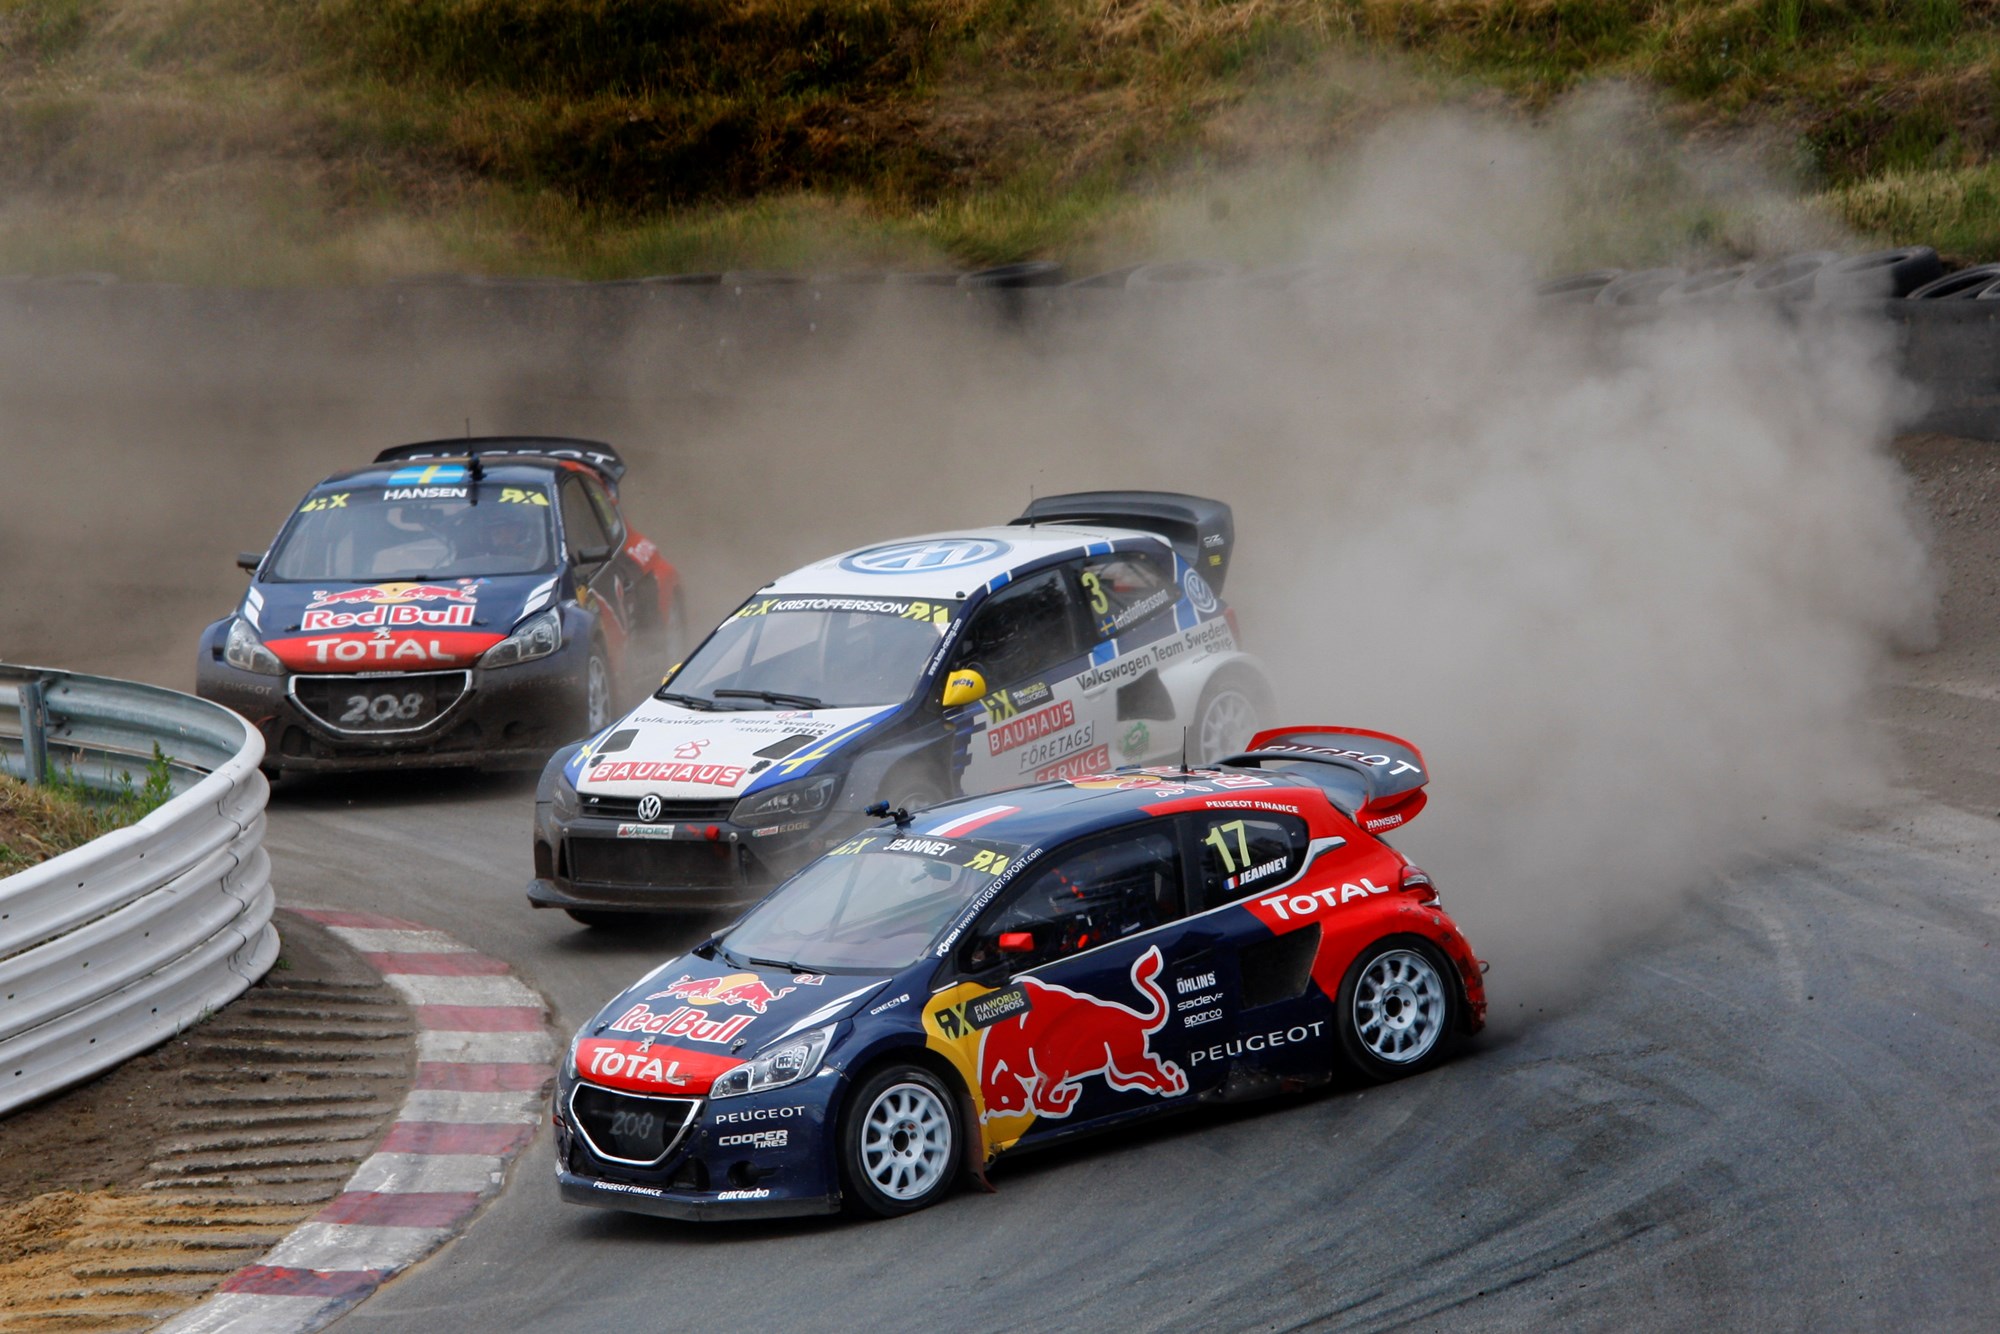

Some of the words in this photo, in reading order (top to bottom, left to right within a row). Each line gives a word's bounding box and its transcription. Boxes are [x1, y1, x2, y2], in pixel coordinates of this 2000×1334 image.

[383, 488, 467, 501] HANSEN
[1081, 572, 1108, 614] 3
[301, 605, 389, 631] Red
[388, 605, 476, 627] Bull
[772, 599, 909, 614] KRISTOFFERSSON
[307, 638, 456, 664] TOTAL
[1077, 654, 1152, 690] Volkswagen
[1151, 640, 1184, 662] Team
[1185, 622, 1229, 650] Sweden
[340, 693, 424, 723] 208
[632, 716, 725, 725] Volkswagen
[776, 718, 837, 729] Sweden
[781, 727, 828, 736] BRIS
[990, 704, 1073, 752] BAUHAUS
[1021, 726, 1092, 769] FÖRETAGS
[1036, 752, 1107, 782] SERVICE
[1250, 745, 1421, 776] EUGEOT
[593, 764, 743, 783] BAUHAUS
[1255, 801, 1299, 814] FINANCE
[779, 822, 810, 833] EDGE
[1366, 813, 1402, 829] HANSEN
[883, 838, 957, 857] JEANNEY
[1205, 819, 1251, 874] 17
[1239, 856, 1288, 885] JEANNEY
[1260, 878, 1389, 920] TOTAL
[1176, 973, 1216, 994] ÖHLINS
[976, 998, 1025, 1023] RALLYCROSS
[1177, 994, 1222, 1011] sadev
[609, 1003, 685, 1034] Red
[662, 1008, 757, 1044] Bull
[1184, 1008, 1222, 1026] sparco
[1190, 1021, 1324, 1067] PEUGEOT
[590, 1047, 687, 1086] TOTAL
[608, 1111, 654, 1140] 208
[716, 1106, 805, 1125] PEUGEOT
[719, 1130, 789, 1146] COOPER
[754, 1139, 788, 1149] TIRES
[593, 1181, 629, 1191] PEUGEOT
[629, 1185, 663, 1197] FINANCE
